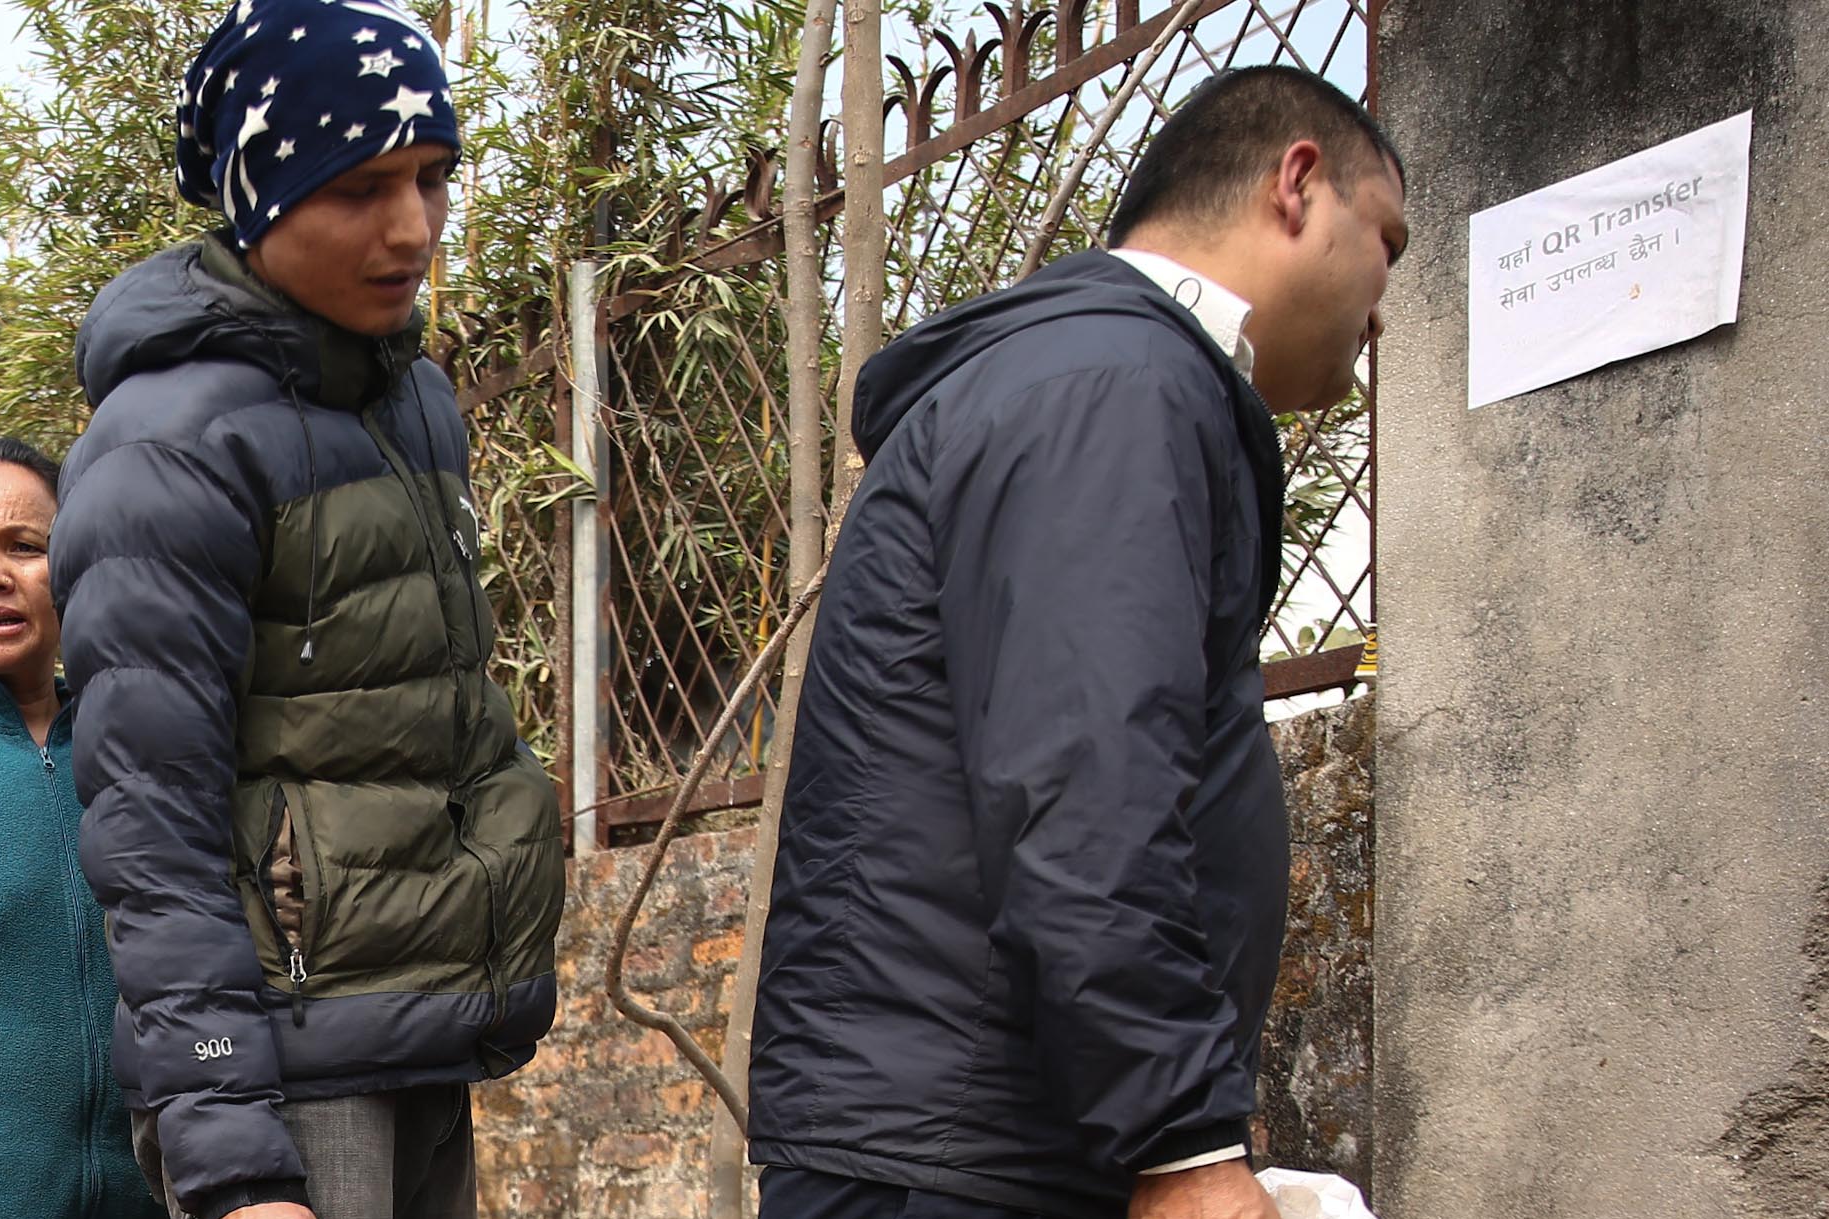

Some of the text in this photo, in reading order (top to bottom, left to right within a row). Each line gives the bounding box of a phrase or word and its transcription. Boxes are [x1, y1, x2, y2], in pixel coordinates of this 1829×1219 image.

[1542, 176, 1705, 256] QR Transfer
[1497, 239, 1532, 272] यहाँ
[1500, 282, 1536, 310] सेवा
[1547, 250, 1617, 293] उपलब्ध
[1628, 232, 1663, 259] छैन
[194, 1037, 233, 1061] 900
